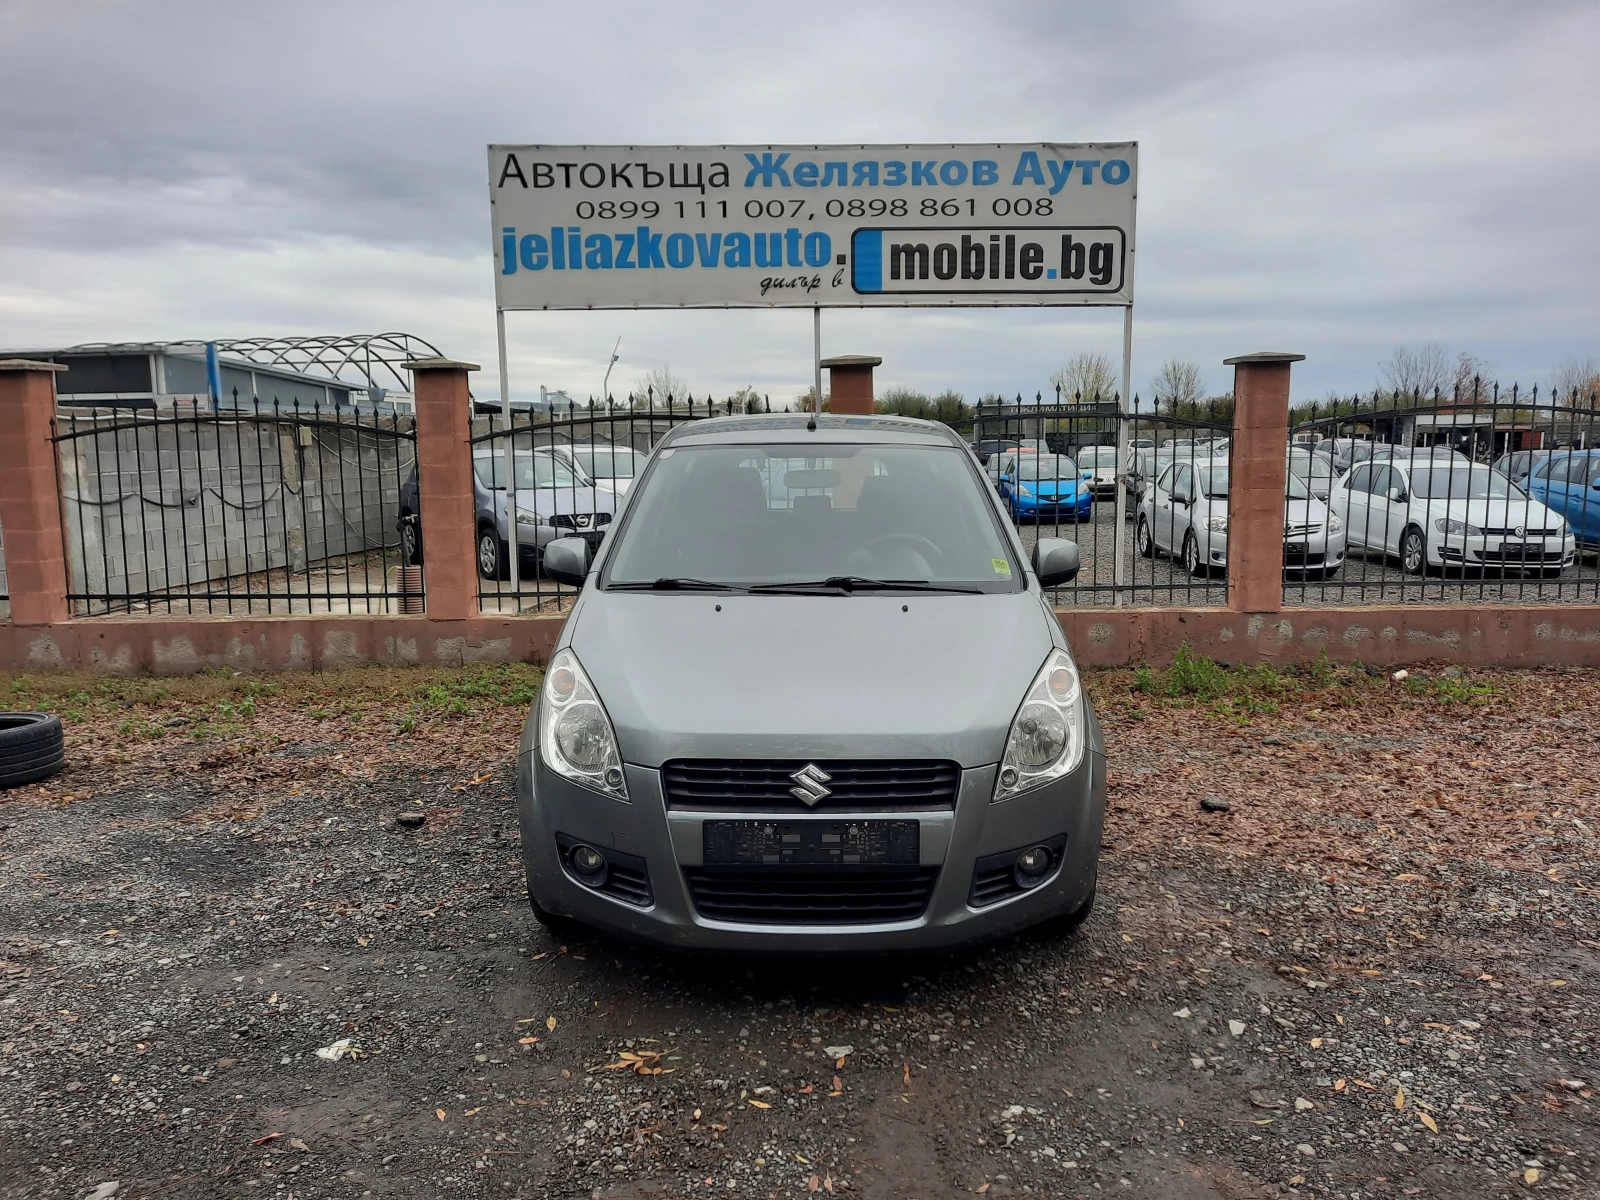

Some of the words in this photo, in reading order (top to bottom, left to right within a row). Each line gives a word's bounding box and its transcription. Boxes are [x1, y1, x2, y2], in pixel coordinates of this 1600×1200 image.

[497, 153, 731, 195] Автокъща
[743, 152, 999, 188] Желязков
[1012, 150, 1131, 196] Ауто
[575, 200, 661, 220] 0899
[673, 200, 728, 219] 111
[743, 199, 816, 221] 007,
[824, 198, 909, 218] 0898
[919, 198, 976, 217] 861
[991, 197, 1055, 217] 008
[889, 233, 1115, 286] mobile.bg
[759, 273, 822, 297] дилър
